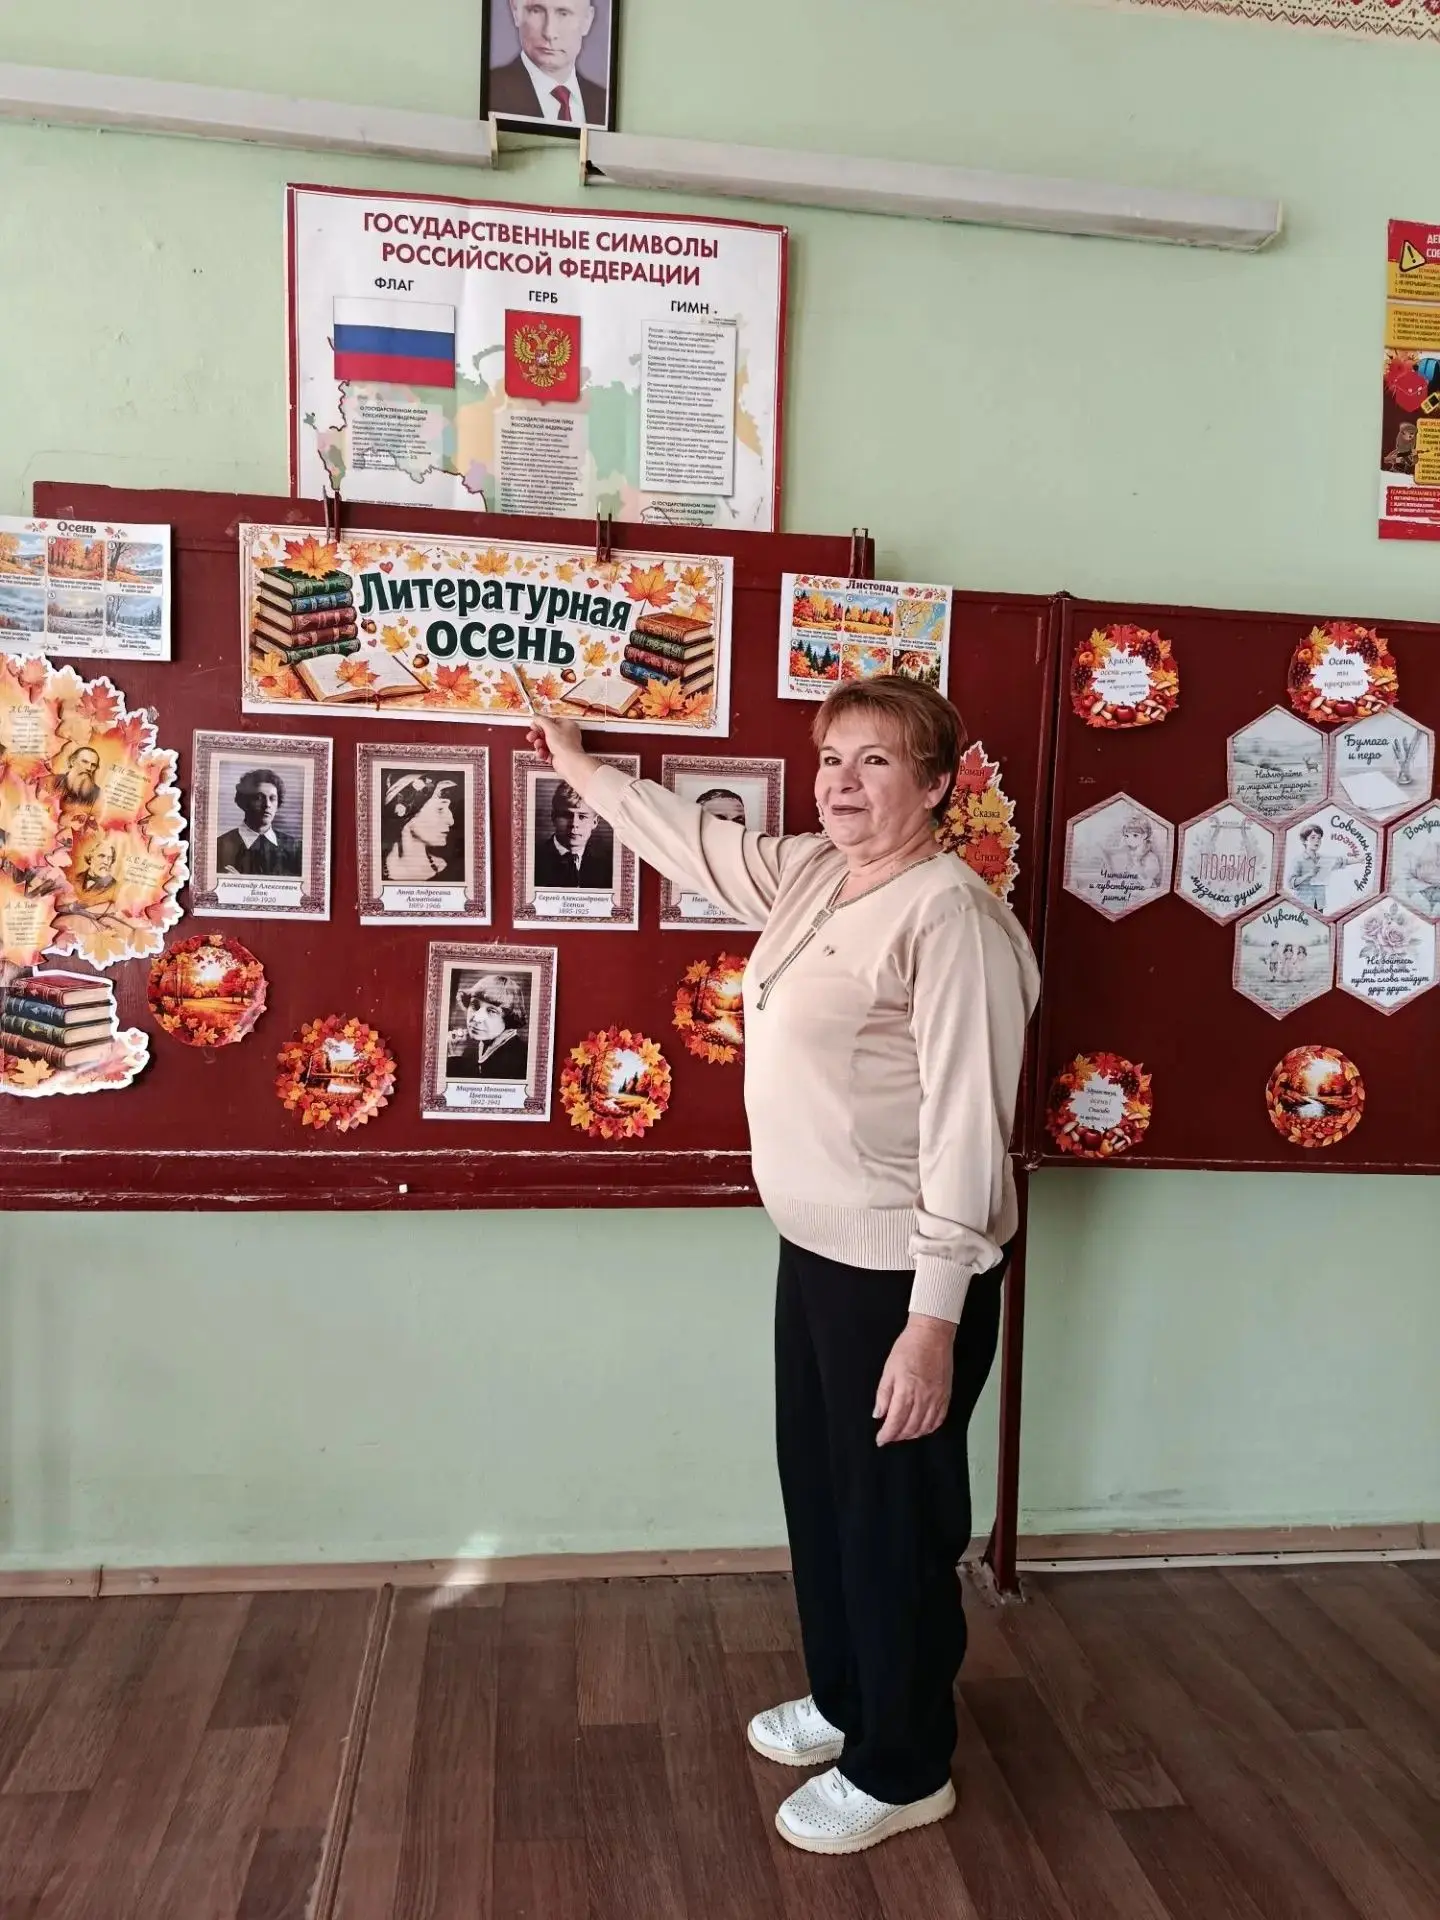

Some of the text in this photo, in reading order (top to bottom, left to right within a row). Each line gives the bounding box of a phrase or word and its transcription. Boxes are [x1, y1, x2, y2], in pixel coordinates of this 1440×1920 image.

[363, 212, 719, 259] ГОСУДАРСТВЕННЫЕ СИМВОЛЫ
[381, 241, 700, 287] РОССИЙСКОЙ ФЕДЕРАЦИИ
[374, 277, 414, 293] ФЛАГ
[528, 290, 558, 305] ГЕРБ
[670, 300, 710, 316] ГИМН
[57, 521, 97, 534] Осень
[846, 580, 899, 595] Листопад
[359, 572, 632, 631] Литературная
[426, 620, 575, 665] осень
[1344, 734, 1390, 748] Бумага
[1357, 752, 1382, 765] перо
[959, 766, 985, 777] Роман
[1255, 770, 1303, 782] Наблюдайте
[973, 808, 1000, 819] Сказка
[1330, 815, 1370, 851] Советы
[1330, 833, 1360, 858] поэту
[974, 852, 1000, 862] Стихи
[1100, 869, 1139, 880] Читайте
[1354, 852, 1373, 892] юному
[1096, 881, 1146, 894] чувствуйте
[1191, 875, 1262, 908] музыка души
[538, 894, 560, 902] Сергей
[1102, 894, 1131, 905] ритм!
[1262, 908, 1309, 928] Чувства
[1366, 955, 1413, 965] Не бойтесь
[1362, 965, 1410, 977] рифмовать
[1351, 973, 1430, 987] пусть слова найдут
[1368, 986, 1411, 996] друг друга.
